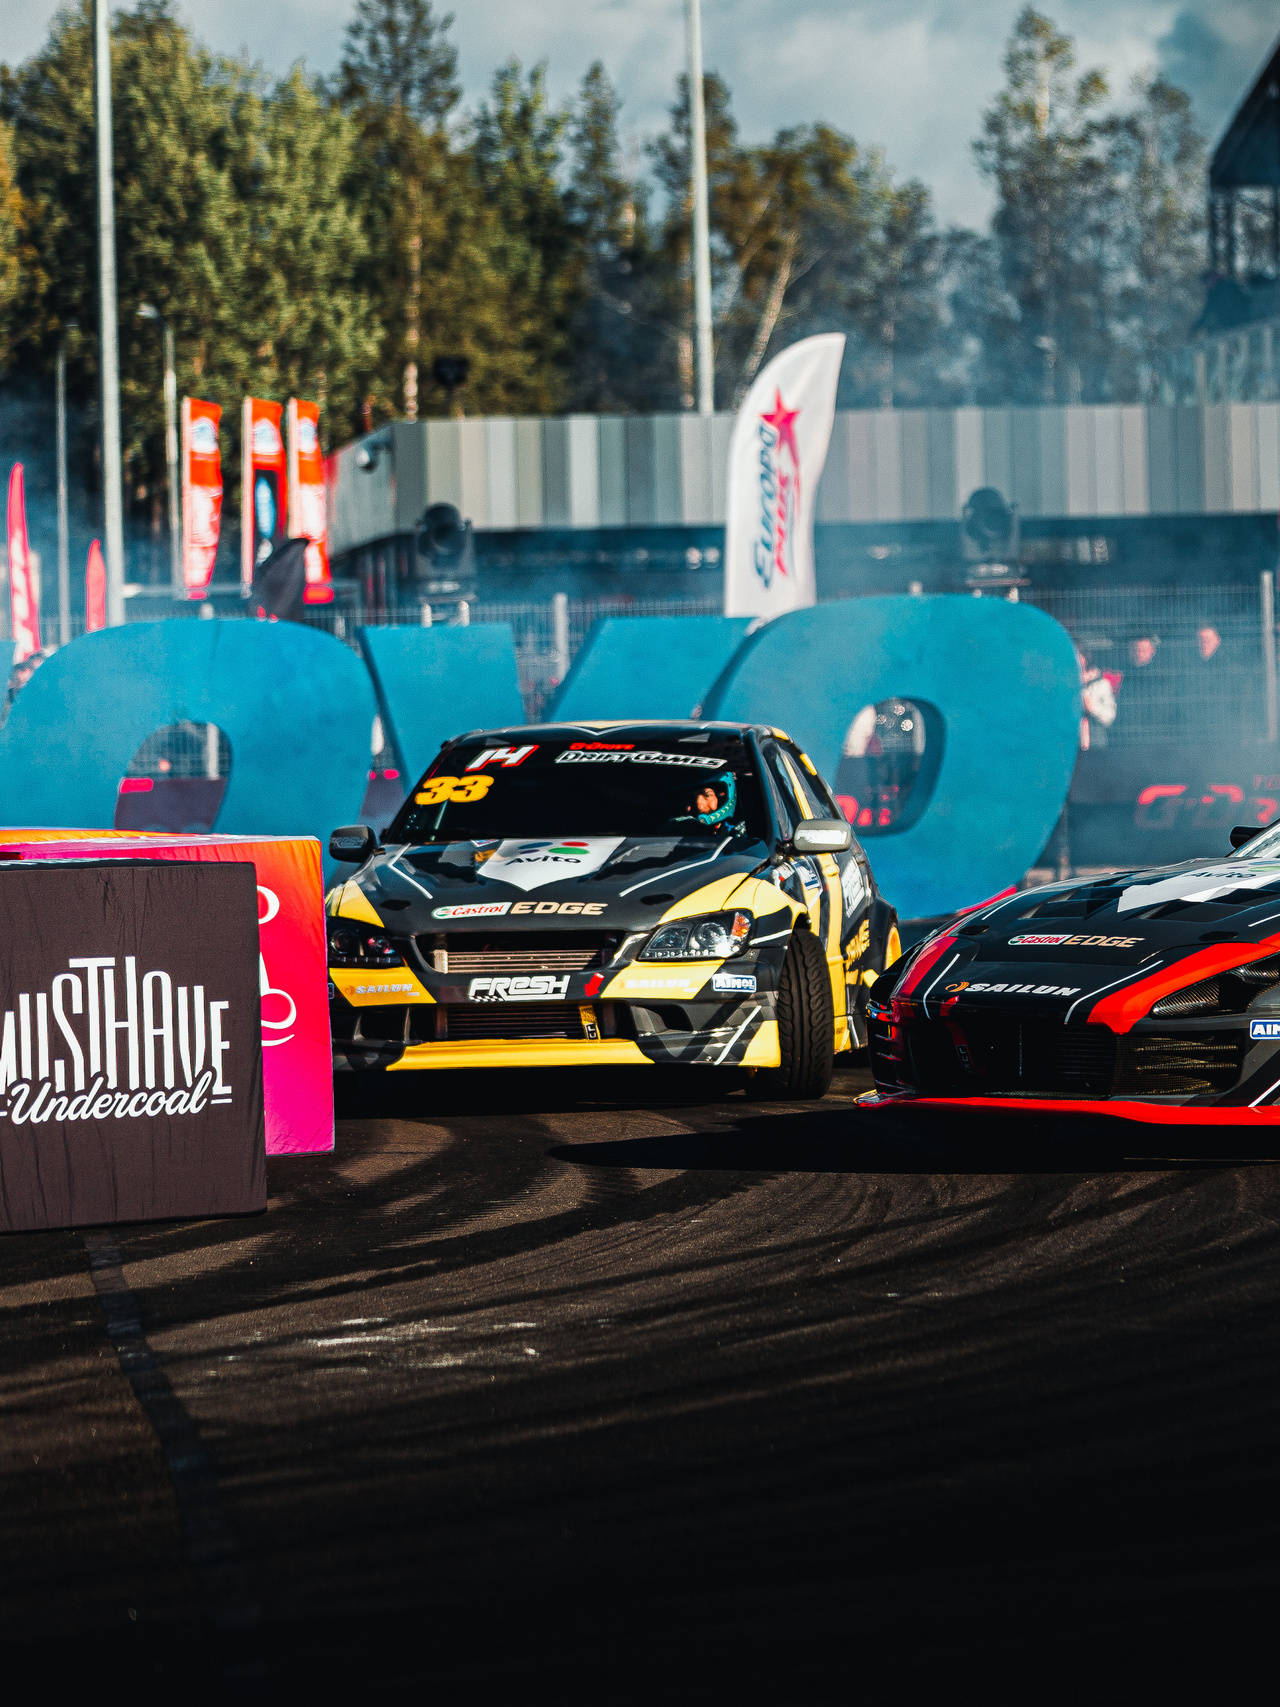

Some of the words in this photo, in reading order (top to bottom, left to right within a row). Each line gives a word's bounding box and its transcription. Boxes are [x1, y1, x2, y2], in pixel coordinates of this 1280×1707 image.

[415, 775, 495, 805] 33
[505, 855, 581, 865] Avito
[452, 904, 504, 917] Castrol
[510, 901, 608, 916] EDGE
[1062, 935, 1145, 948] EDGE
[356, 983, 413, 994] SAILUN
[468, 975, 571, 1001] FRESH
[967, 982, 1081, 996] SAILUN
